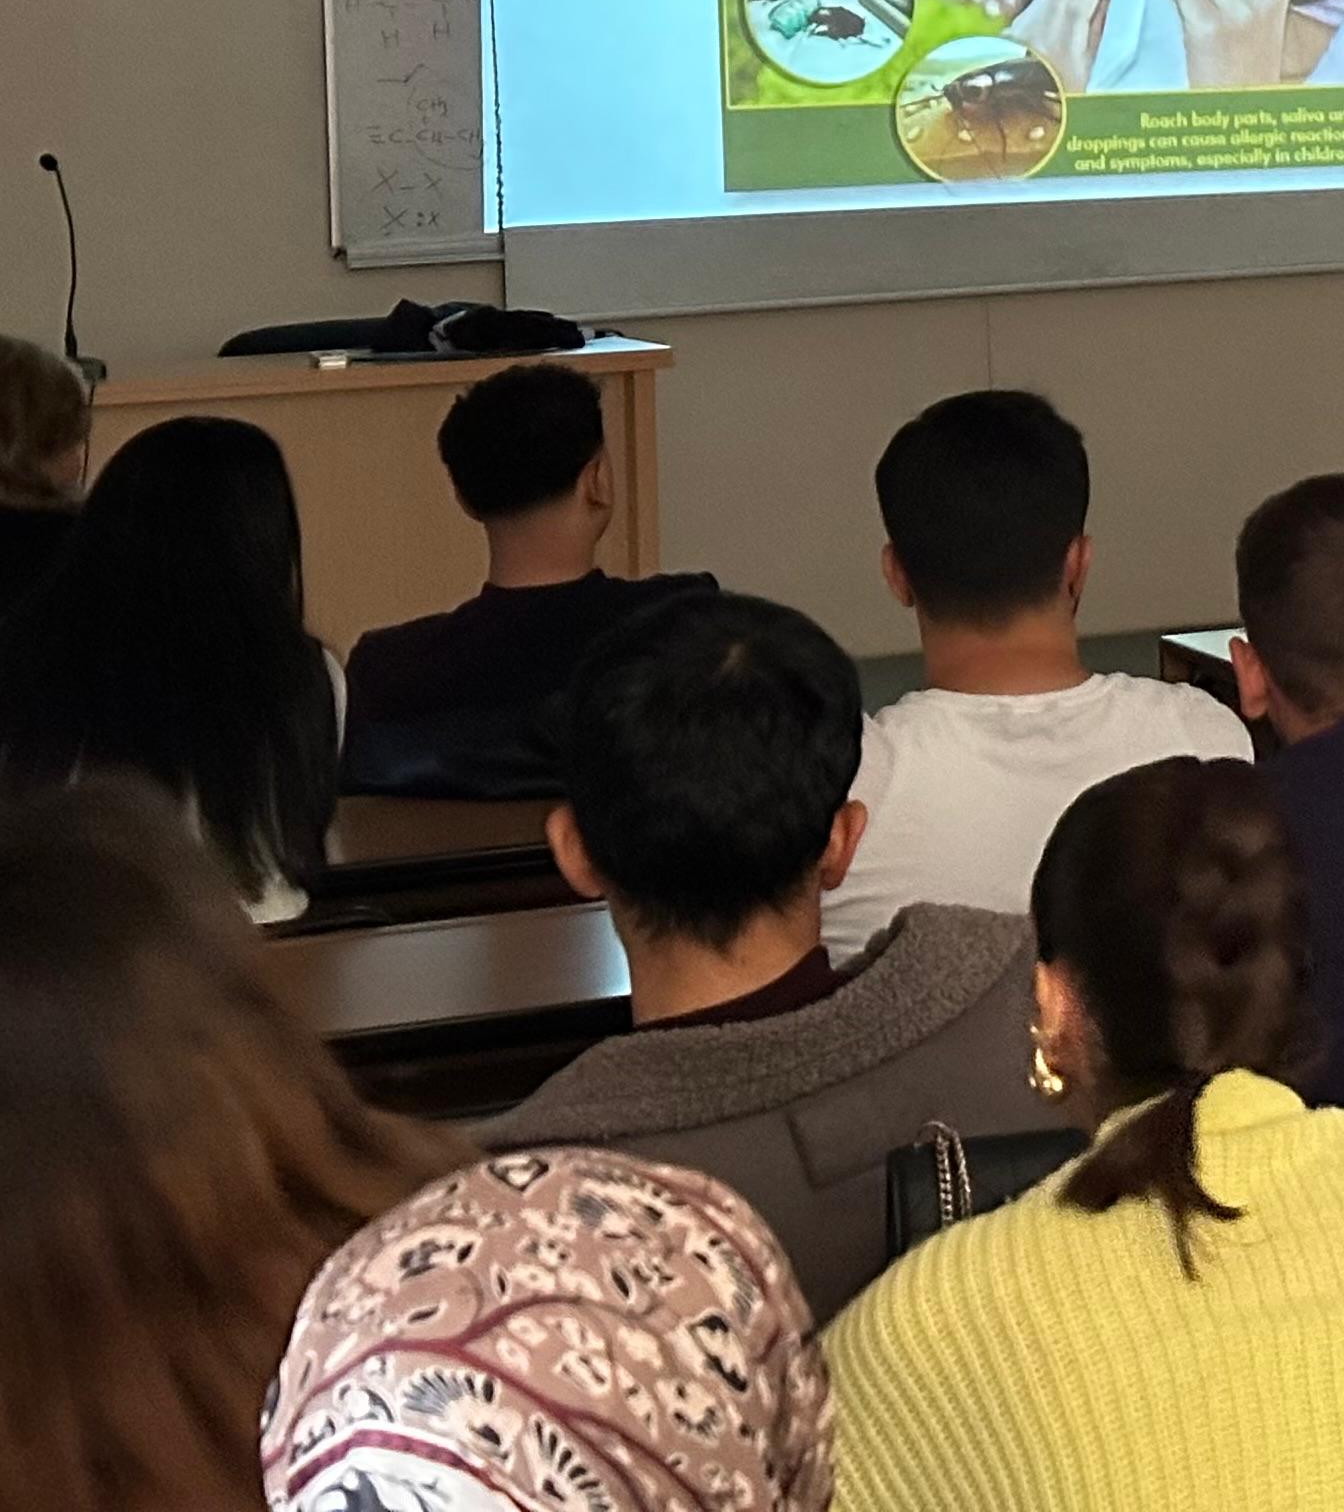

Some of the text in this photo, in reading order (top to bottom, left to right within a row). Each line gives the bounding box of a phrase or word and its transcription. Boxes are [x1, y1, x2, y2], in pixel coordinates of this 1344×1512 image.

[1140, 112, 1188, 129] Roach
[1191, 110, 1229, 130] body
[1234, 109, 1278, 128] parts,
[1281, 107, 1325, 124] saliva
[1067, 135, 1146, 153] droppings
[1149, 136, 1178, 149] can
[1181, 134, 1226, 148] cause
[1230, 130, 1287, 148] allergic
[1074, 156, 1106, 171] and
[1109, 155, 1192, 173] symptoms,
[1196, 148, 1271, 168] especially
[1275, 148, 1290, 164] in
